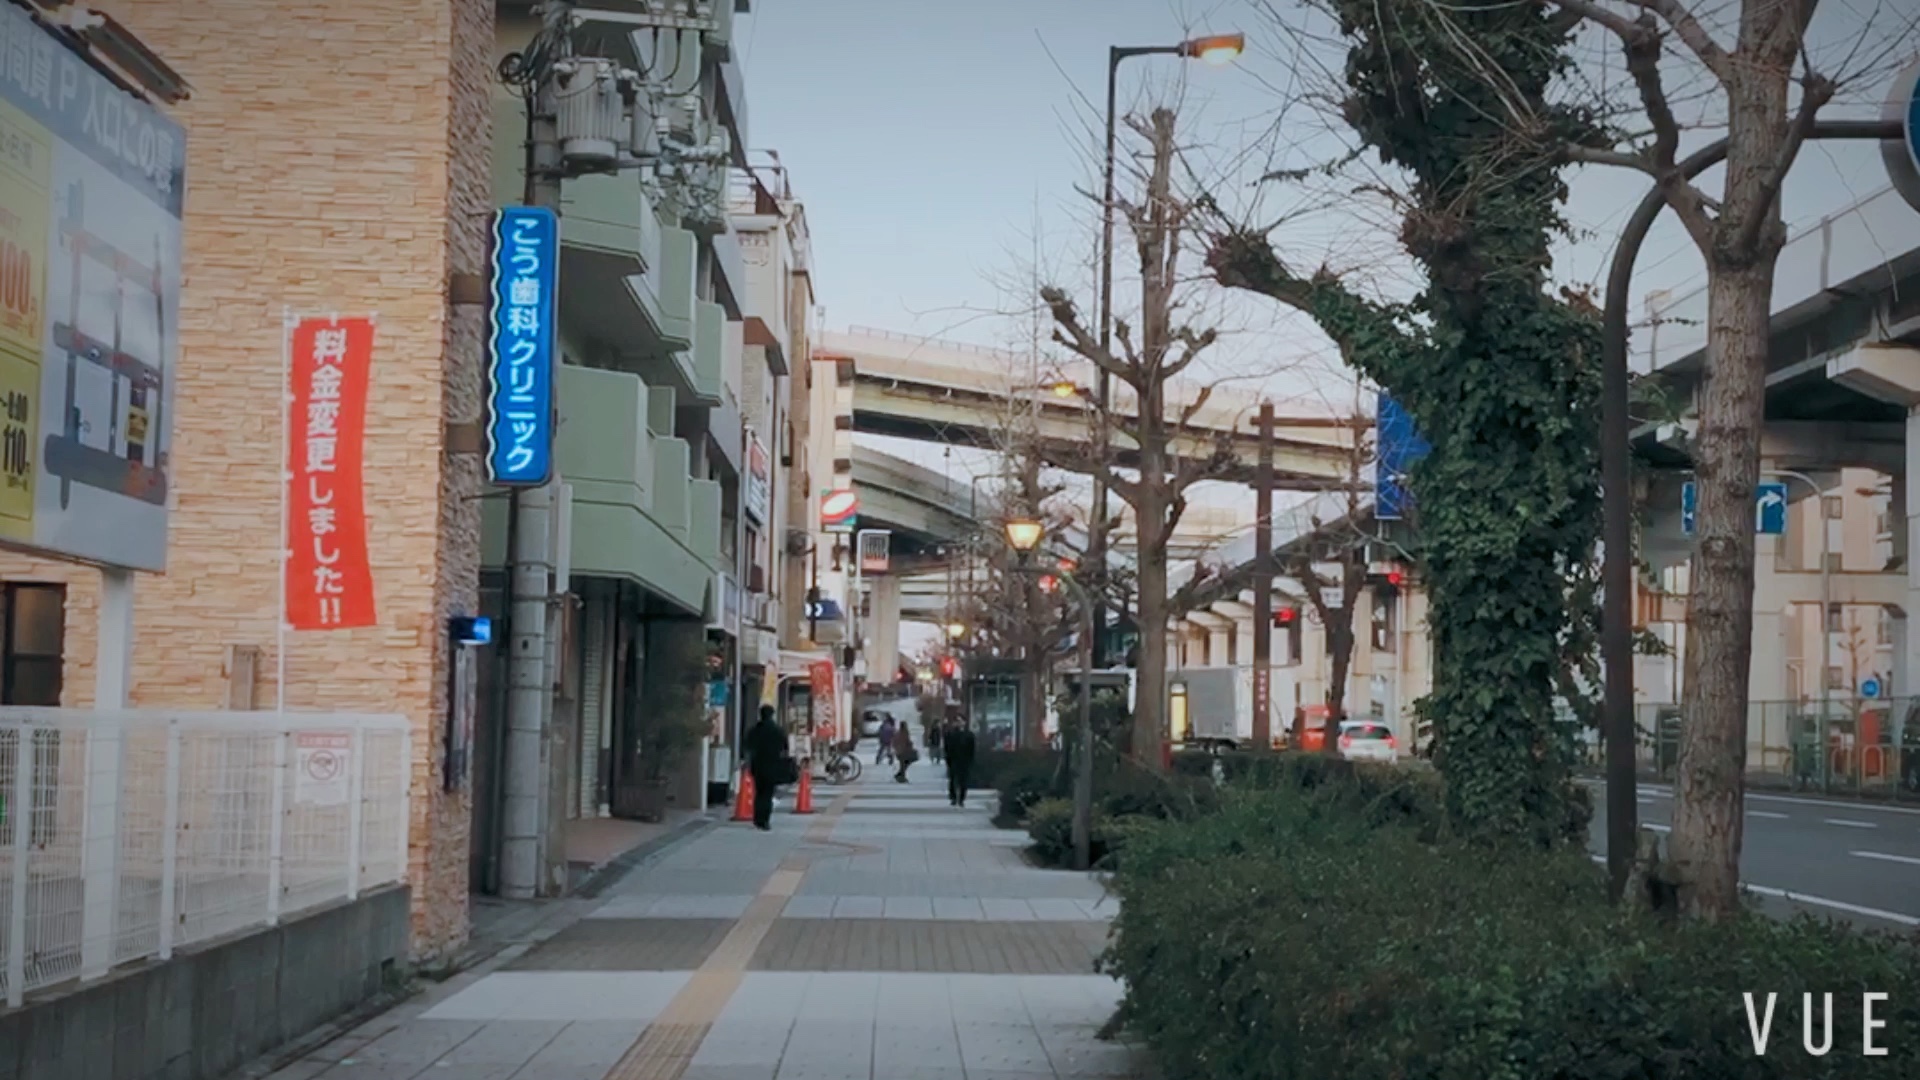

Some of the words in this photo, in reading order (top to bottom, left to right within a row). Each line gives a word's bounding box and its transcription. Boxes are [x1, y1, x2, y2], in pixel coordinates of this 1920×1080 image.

[304, 328, 346, 624] 料金変更しました!!
[506, 217, 541, 473] こう歯科クリニック
